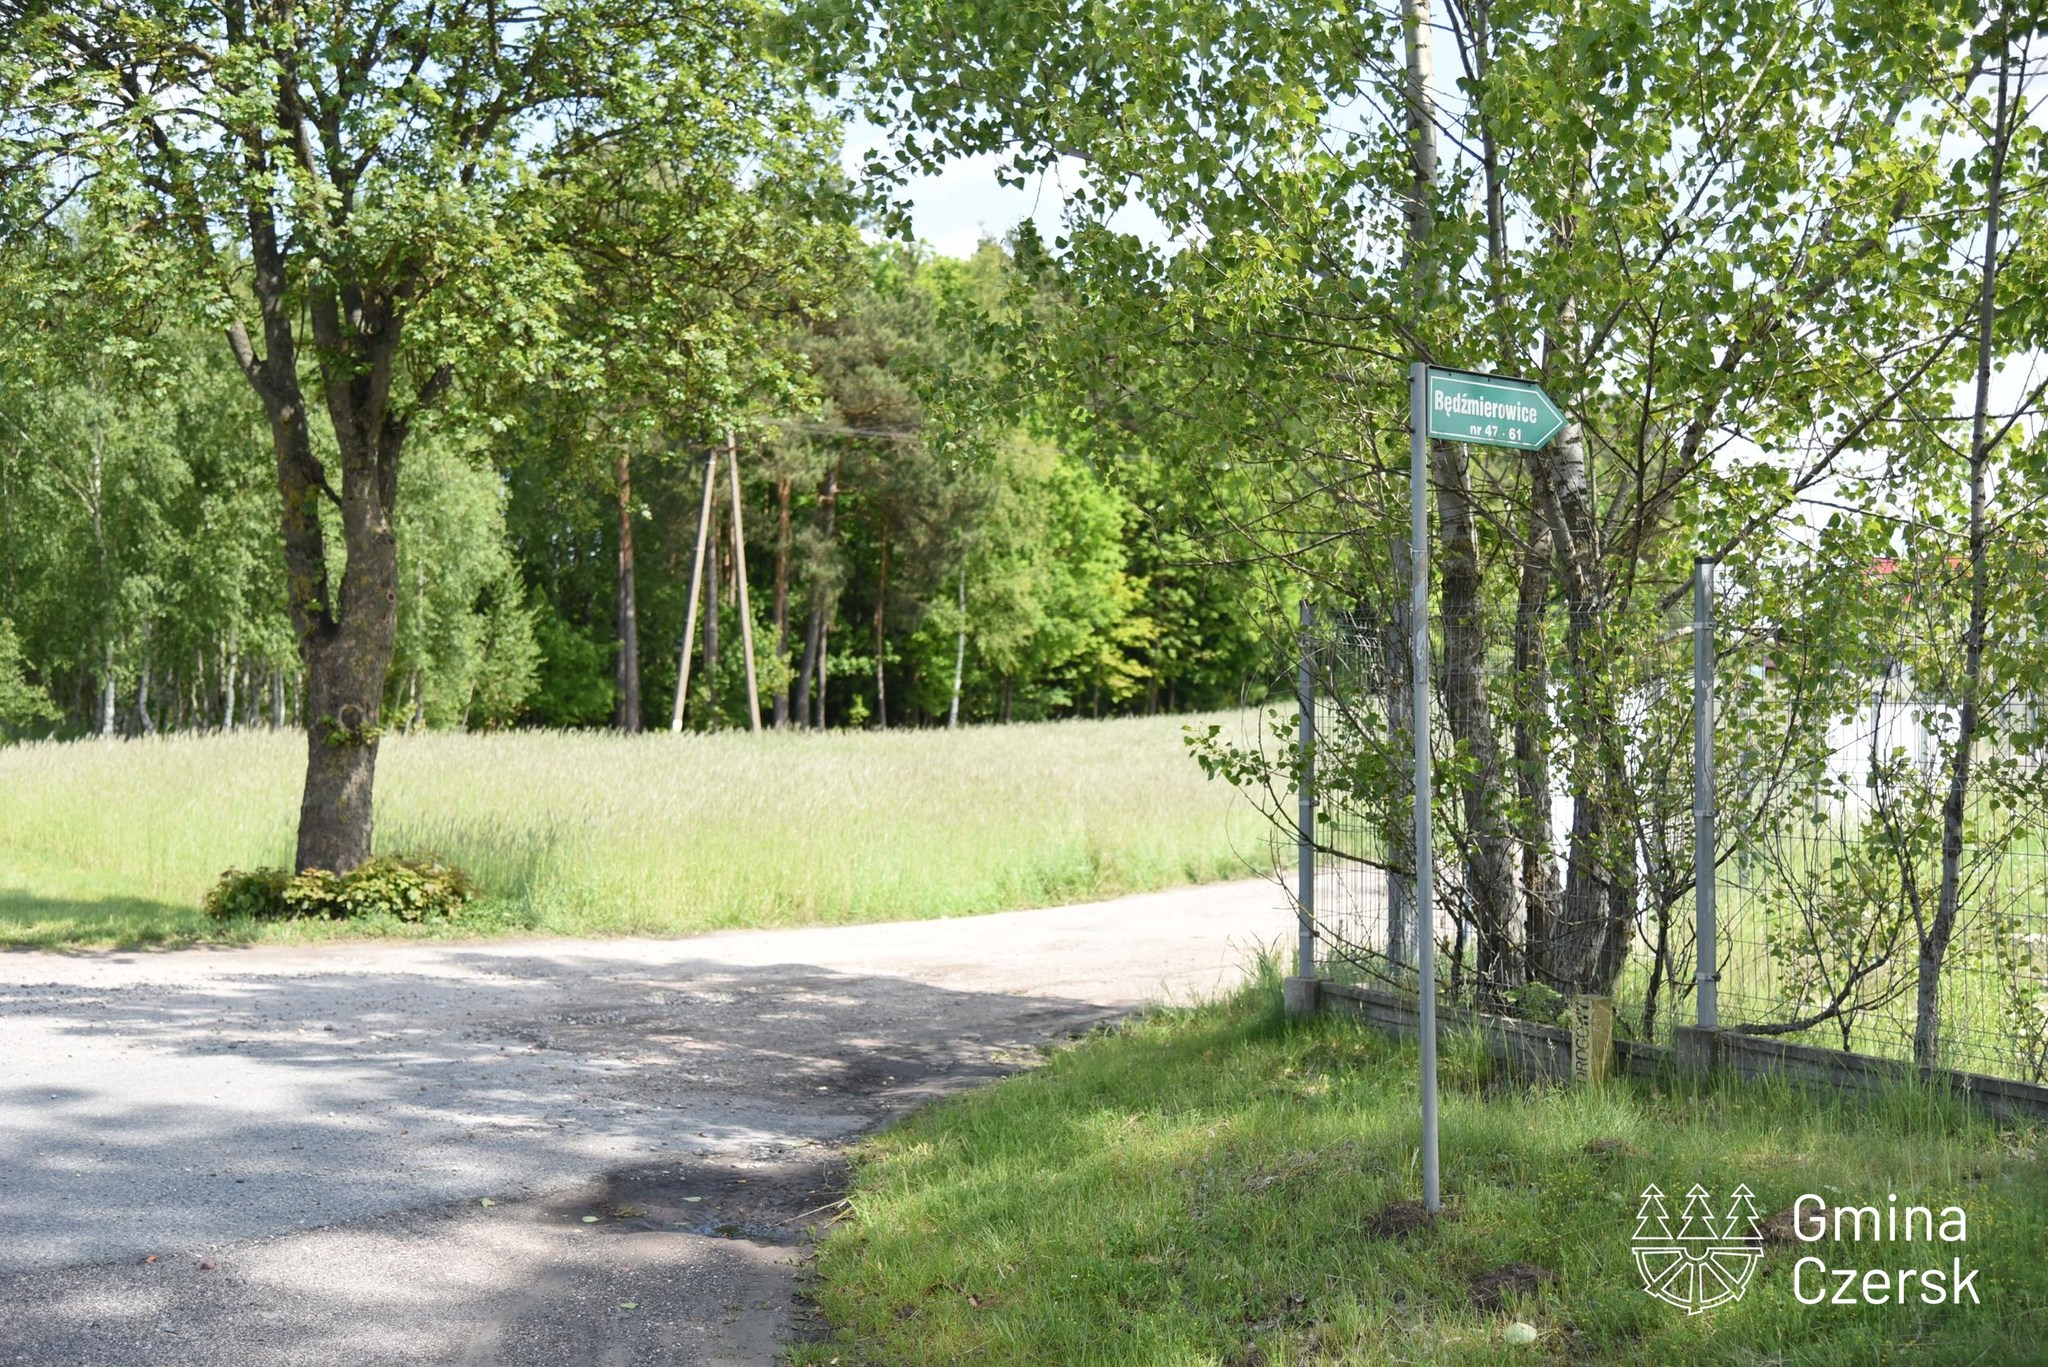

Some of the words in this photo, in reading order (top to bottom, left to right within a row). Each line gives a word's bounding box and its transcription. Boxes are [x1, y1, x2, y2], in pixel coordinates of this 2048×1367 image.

[1434, 390, 1537, 423] Będźmierowice
[1469, 425, 1482, 436] nr
[1484, 424, 1499, 437] 47
[1508, 427, 1522, 441] 61
